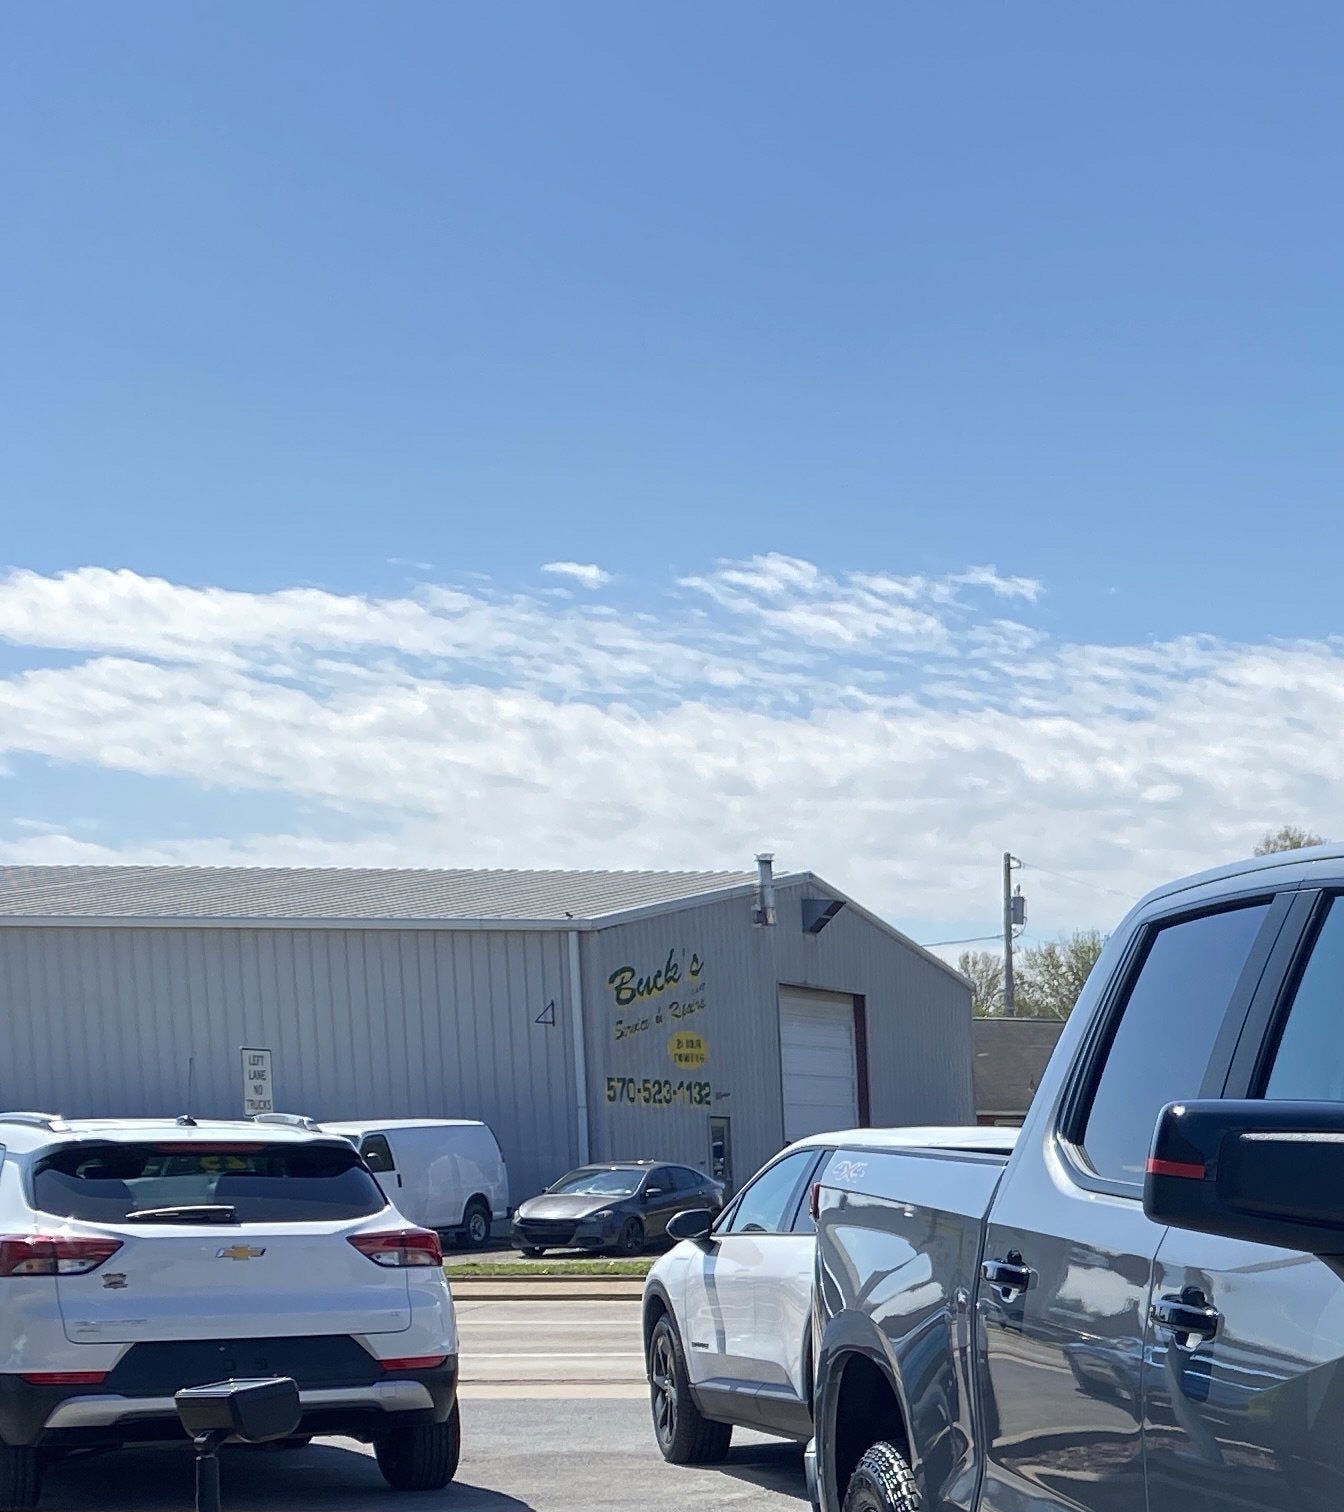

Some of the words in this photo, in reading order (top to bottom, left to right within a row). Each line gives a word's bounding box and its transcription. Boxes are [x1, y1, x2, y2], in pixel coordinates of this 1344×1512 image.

[608, 947, 704, 1006] Buck's
[248, 1054, 265, 1067] LEFT
[248, 1069, 267, 1081] LANE
[253, 1084, 263, 1096] NO
[246, 1098, 272, 1111] TRUCKS
